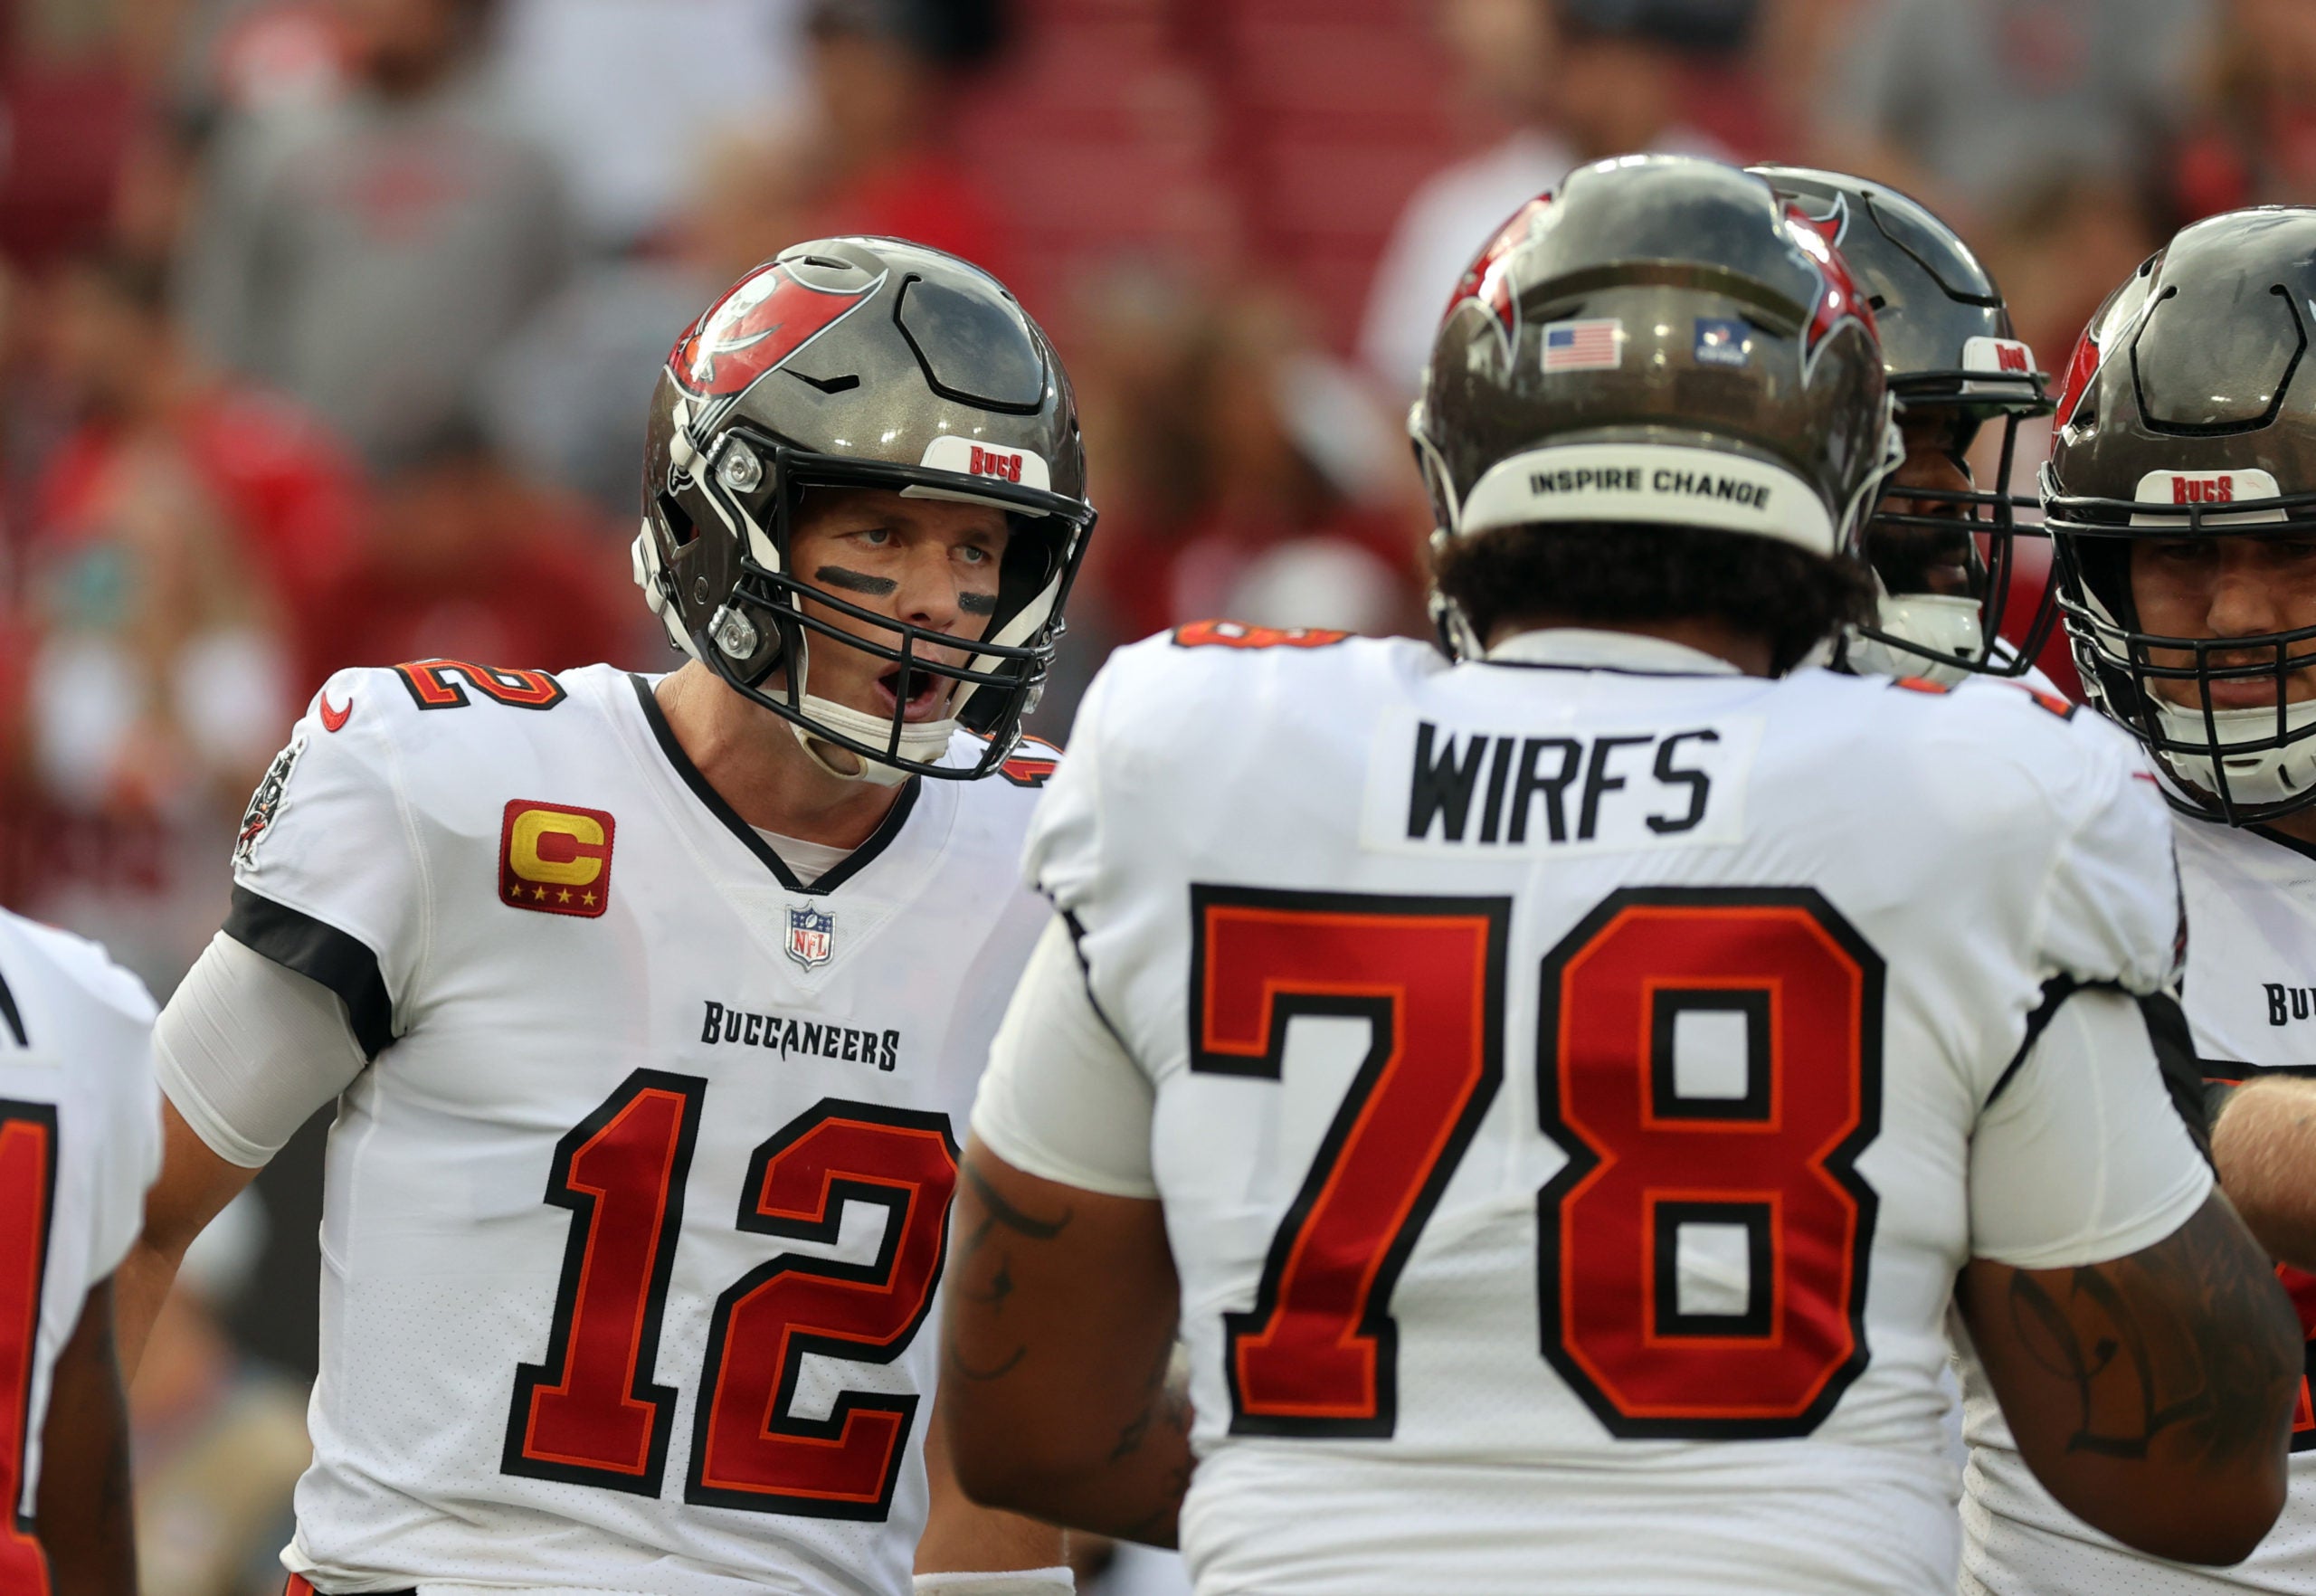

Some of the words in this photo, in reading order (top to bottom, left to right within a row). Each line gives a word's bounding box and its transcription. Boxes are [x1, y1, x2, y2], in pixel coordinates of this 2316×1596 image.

[970, 445, 1022, 483] BUCS
[1531, 468, 1642, 495] INSPIRE
[1653, 469, 1770, 509] CHANGE
[2171, 476, 2232, 505] BUCS
[1407, 720, 1720, 843] WIRFS
[510, 809, 605, 886] C
[793, 929, 827, 958] NFL
[701, 1000, 900, 1071] BUCCANEERS
[1189, 882, 1887, 1439] 78
[500, 1067, 963, 1522] 12
